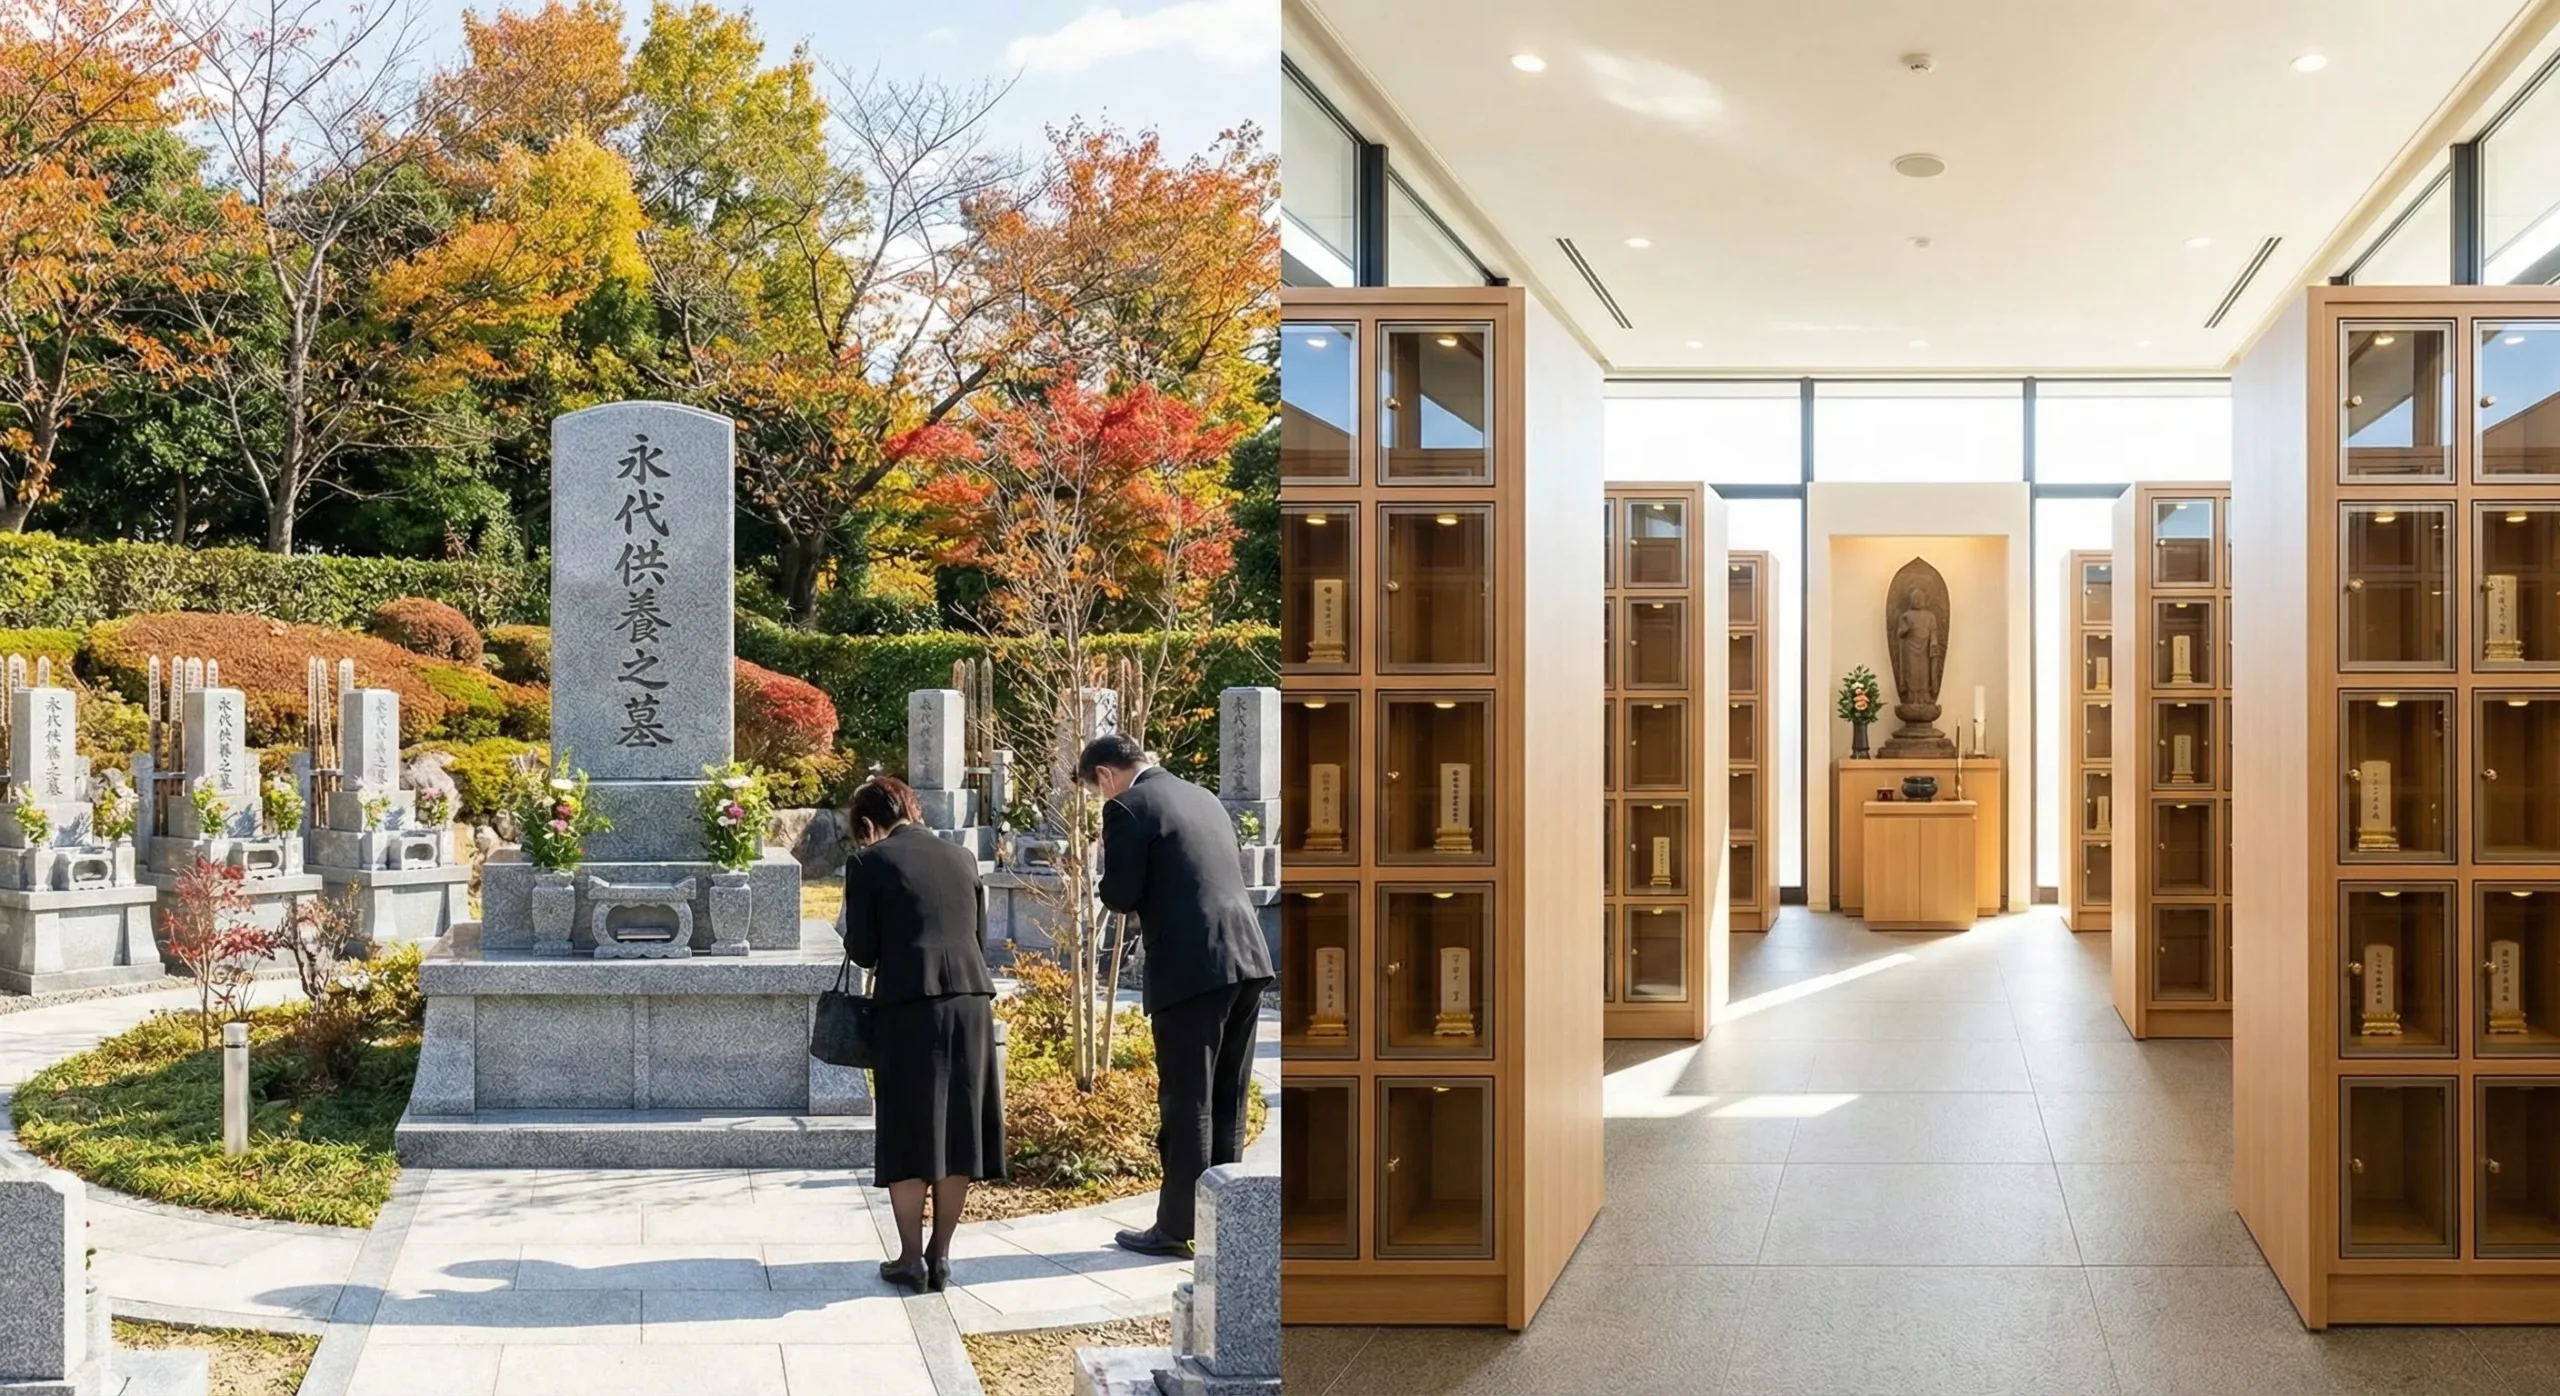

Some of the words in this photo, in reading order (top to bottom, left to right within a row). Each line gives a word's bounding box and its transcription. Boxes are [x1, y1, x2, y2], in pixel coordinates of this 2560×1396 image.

[614, 434, 673, 748] 永代供養之墓
